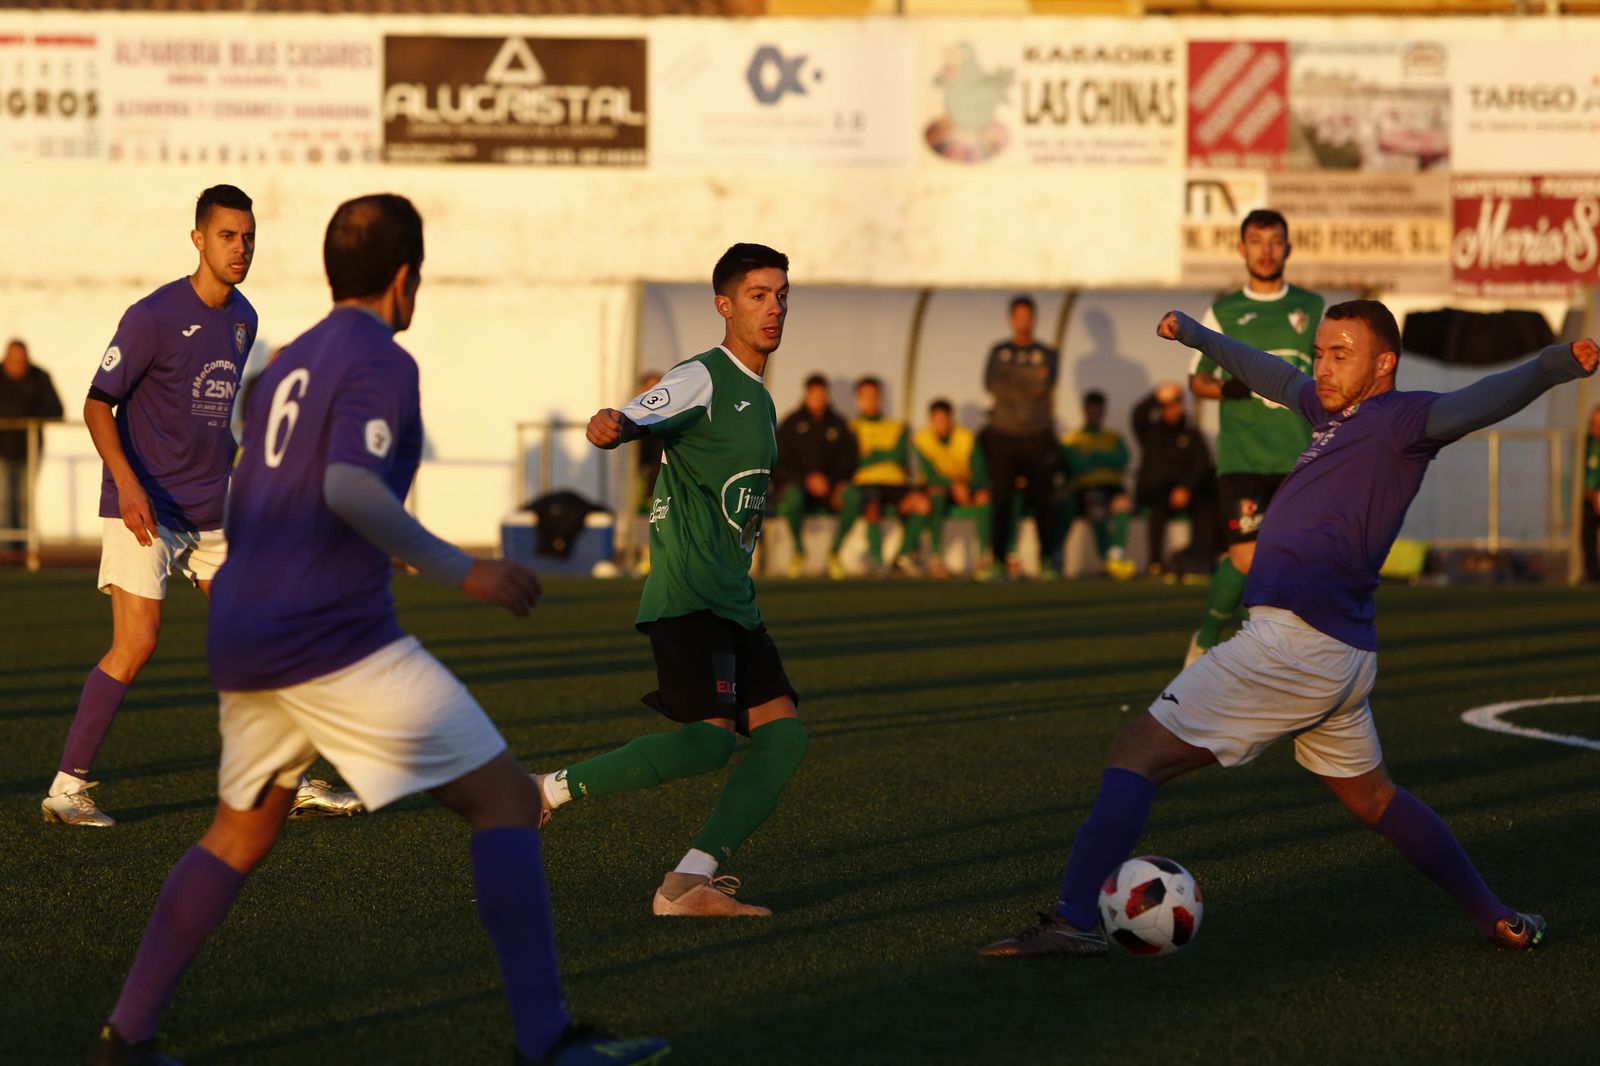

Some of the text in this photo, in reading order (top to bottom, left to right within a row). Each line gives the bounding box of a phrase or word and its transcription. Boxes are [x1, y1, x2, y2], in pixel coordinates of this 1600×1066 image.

[1022, 46, 1176, 64] KARAOKE
[383, 82, 648, 126] ALUCRISTAL
[1021, 78, 1177, 126] LAS CHINAS
[1468, 84, 1576, 113] TARGO
[204, 378, 237, 400] 25N
[264, 367, 310, 469] 6
